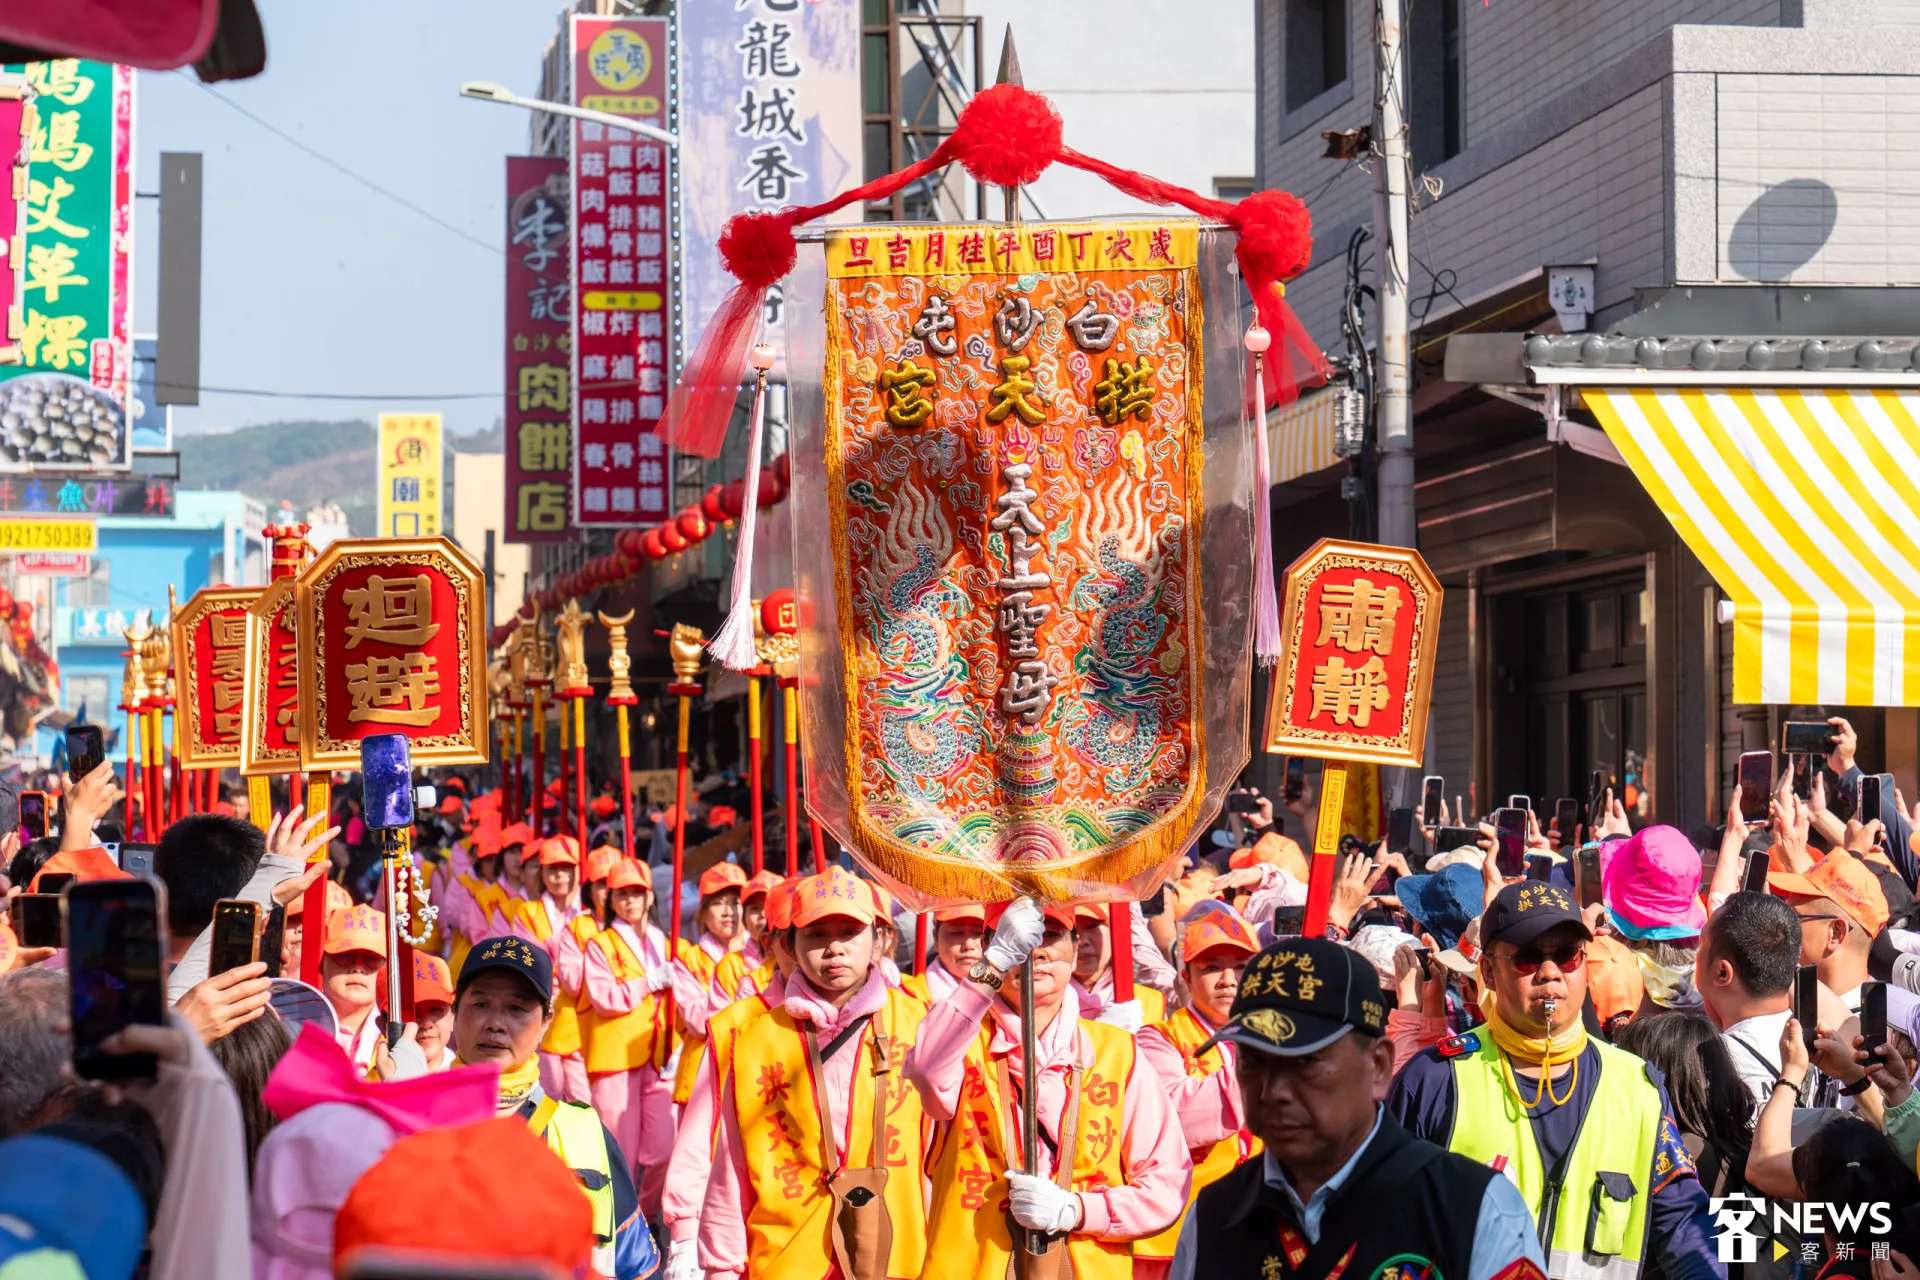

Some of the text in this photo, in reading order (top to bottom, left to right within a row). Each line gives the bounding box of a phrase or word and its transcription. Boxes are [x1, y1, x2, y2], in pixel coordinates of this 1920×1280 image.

[738, 0, 804, 216] 龍城香
[516, 363, 568, 532] 肉餅店
[342, 572, 442, 728] 迴避
[990, 462, 1060, 724] 天上聖母
[1308, 578, 1404, 729] 肅靜
[755, 1060, 807, 1201] 拱天宮
